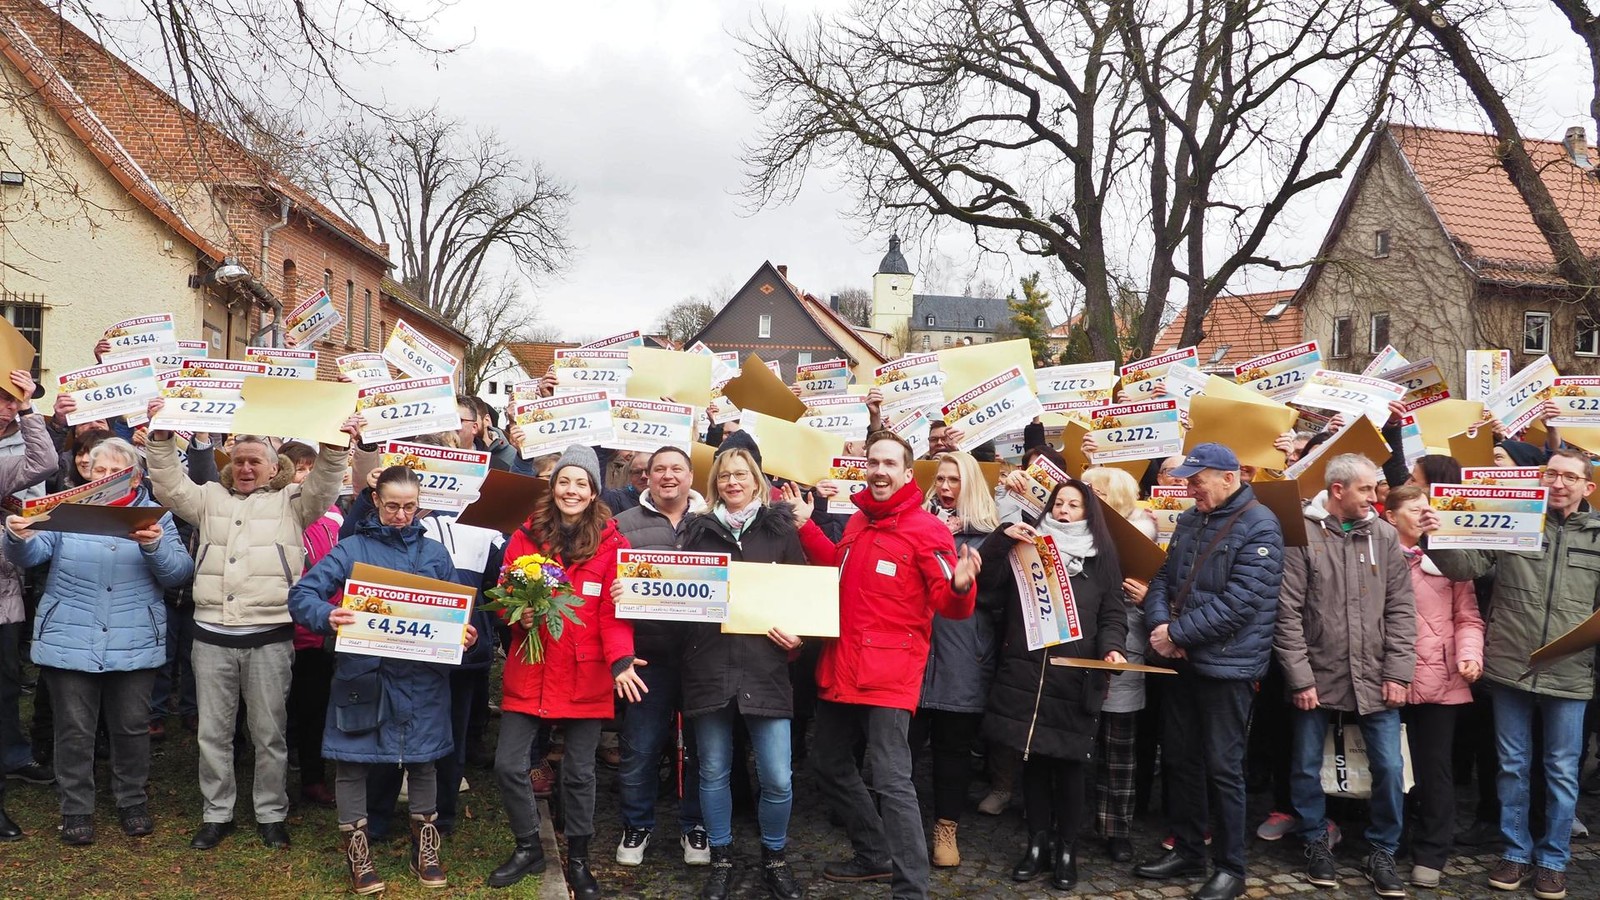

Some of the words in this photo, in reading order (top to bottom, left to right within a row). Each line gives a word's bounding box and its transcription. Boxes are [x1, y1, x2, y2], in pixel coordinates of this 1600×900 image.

[1240, 356, 1277, 372] POSTCODE
[1277, 346, 1310, 361] LOTTERIE
[1096, 406, 1132, 417] POSTCODE
[1132, 402, 1169, 413] LOTTERIE
[397, 446, 441, 457] POSTCODE
[442, 450, 480, 462] LOTTERIE
[1442, 488, 1492, 497] POSTCODE
[1492, 489, 1536, 499] LOTTERIE
[629, 553, 676, 563] POSTCODE
[677, 556, 720, 565] LOTTERIE
[1048, 543, 1066, 588] POSTCODE
[1060, 587, 1077, 629] LOTTERIE
[357, 586, 410, 601] POSTCODE
[411, 594, 458, 607] LOTTERIE
